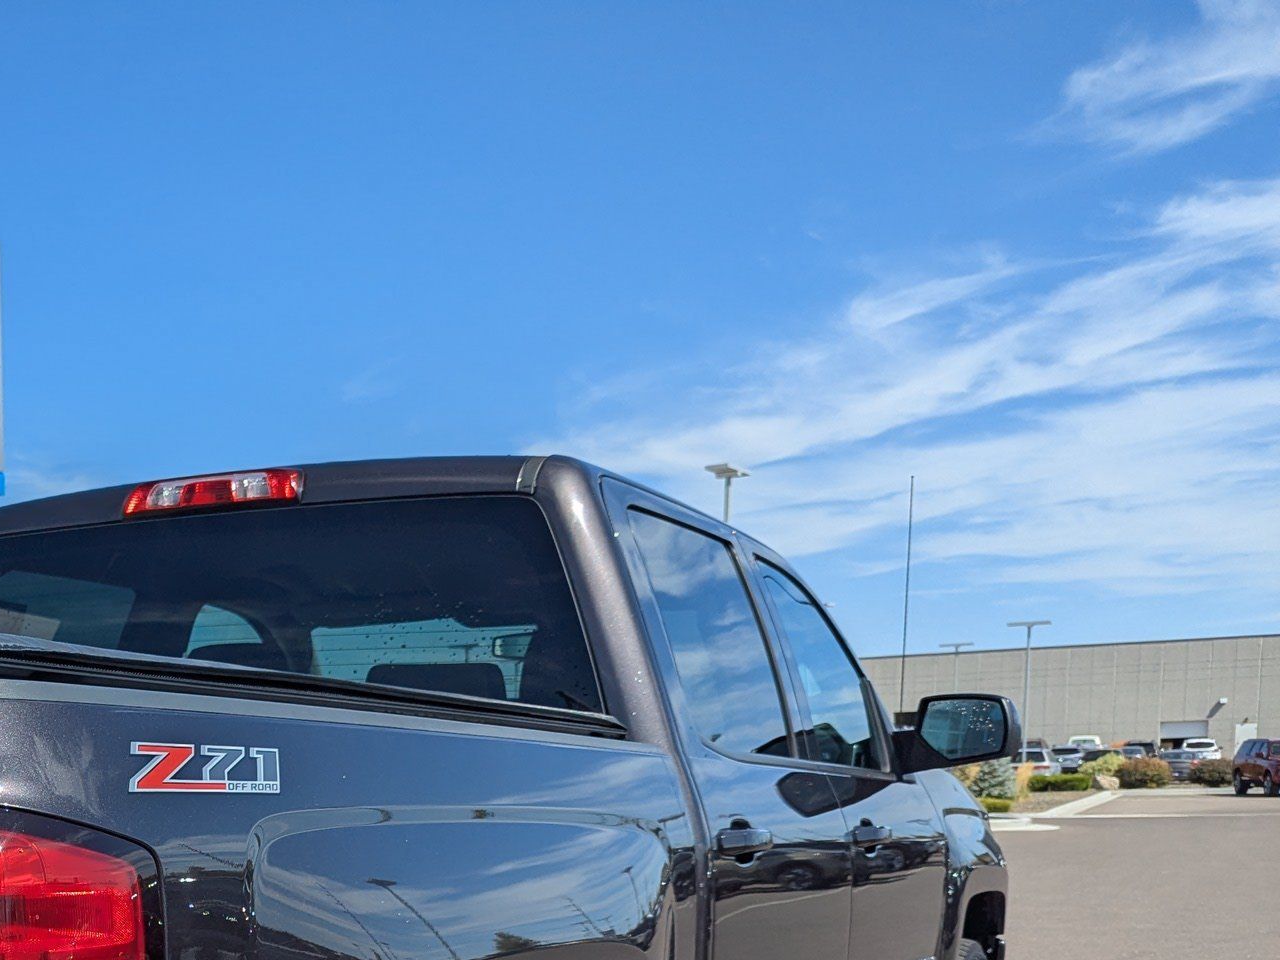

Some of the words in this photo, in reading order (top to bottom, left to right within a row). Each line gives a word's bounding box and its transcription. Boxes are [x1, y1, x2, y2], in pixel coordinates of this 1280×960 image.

[129, 741, 280, 793] Z71
[228, 782, 248, 791] OFF
[251, 782, 278, 792] ROAD
